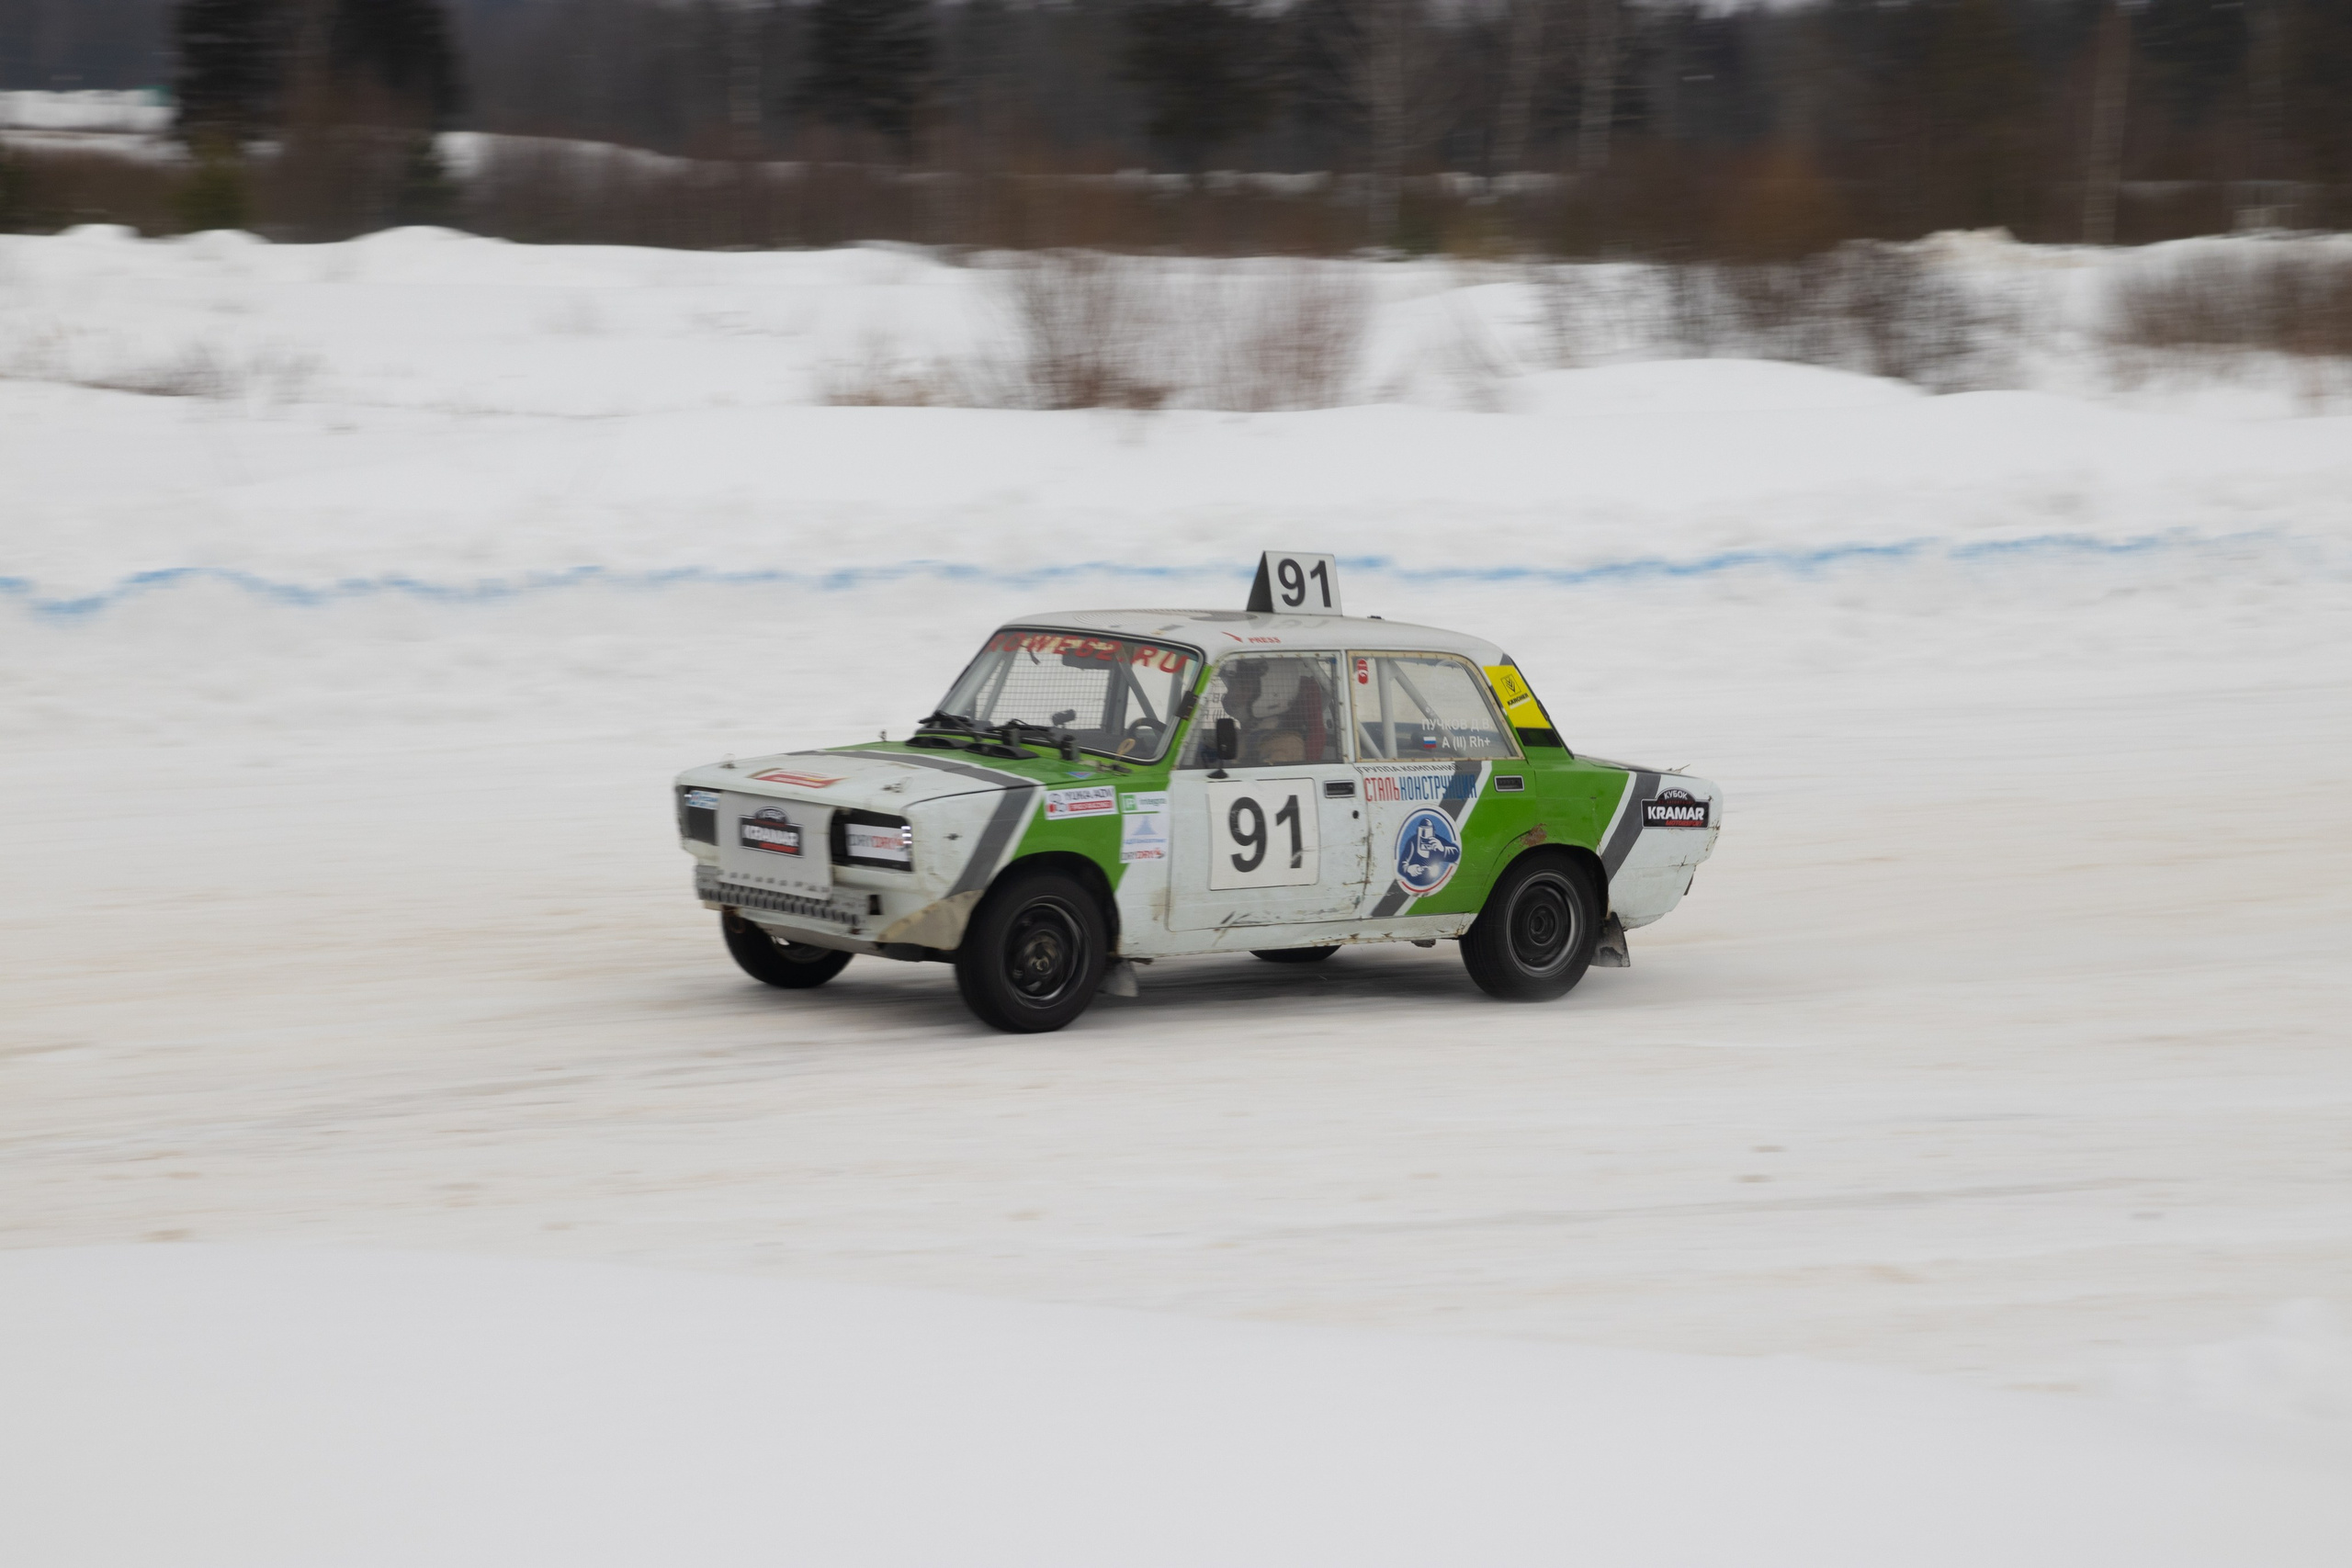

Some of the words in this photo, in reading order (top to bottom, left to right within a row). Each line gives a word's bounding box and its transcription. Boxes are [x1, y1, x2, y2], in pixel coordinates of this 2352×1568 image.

[1277, 558, 1332, 608] 91
[1421, 718, 1467, 731] ПУЧКОВ
[1442, 736, 1451, 749] A
[1469, 735, 1491, 749] Rh+
[1356, 765, 1401, 774] ГРУППА
[1664, 790, 1688, 800] КУБОК
[1647, 807, 1705, 820] KRAMAR
[1229, 795, 1303, 873] 91
